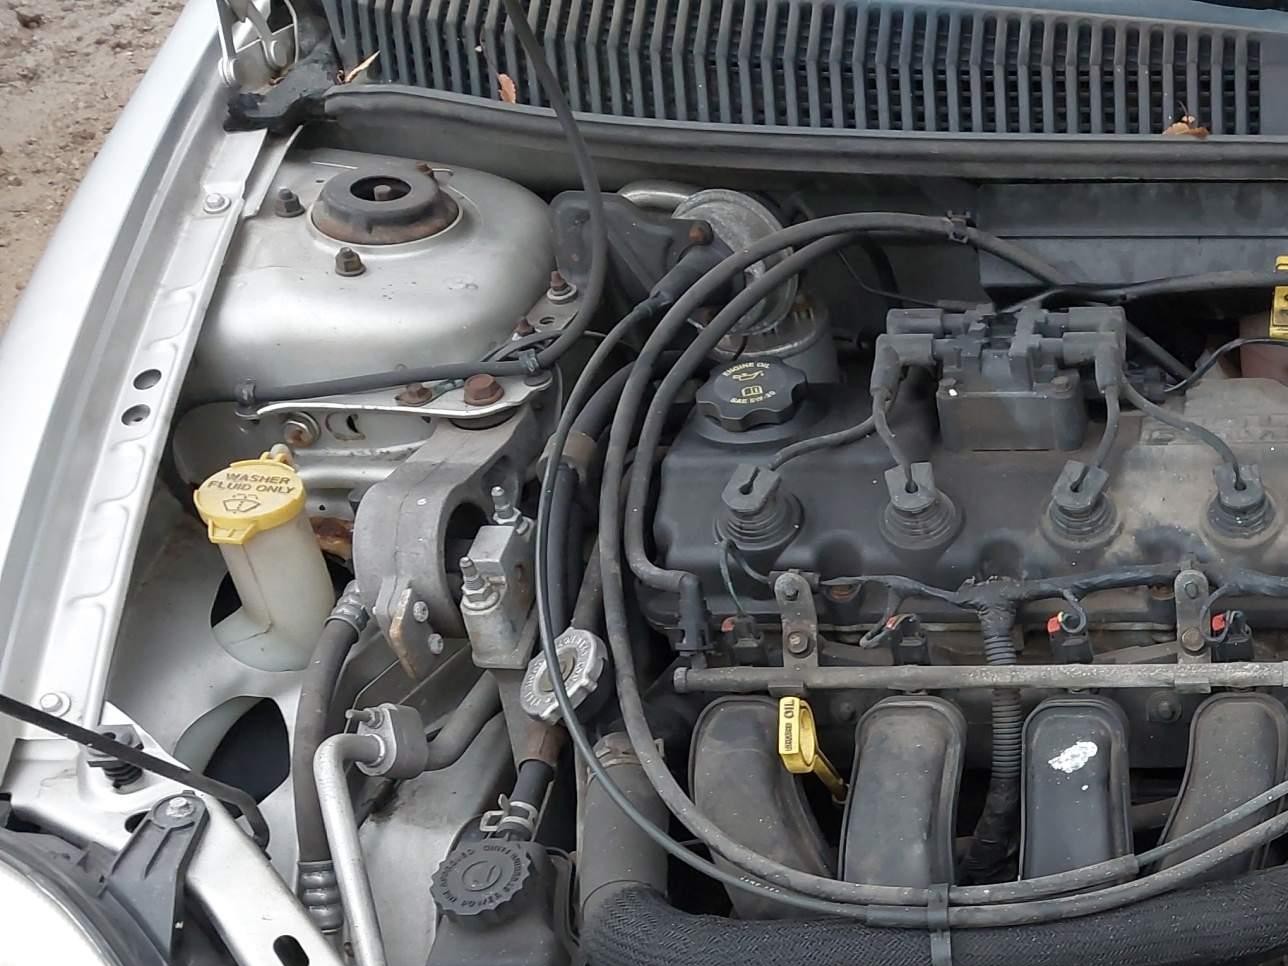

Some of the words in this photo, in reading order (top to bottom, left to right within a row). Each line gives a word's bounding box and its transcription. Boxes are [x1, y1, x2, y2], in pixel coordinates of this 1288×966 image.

[722, 362, 755, 377] ENGINE
[226, 472, 291, 485] WASHER
[207, 480, 252, 491] FLUID
[255, 484, 296, 494] ONLY
[783, 699, 795, 719] OIL
